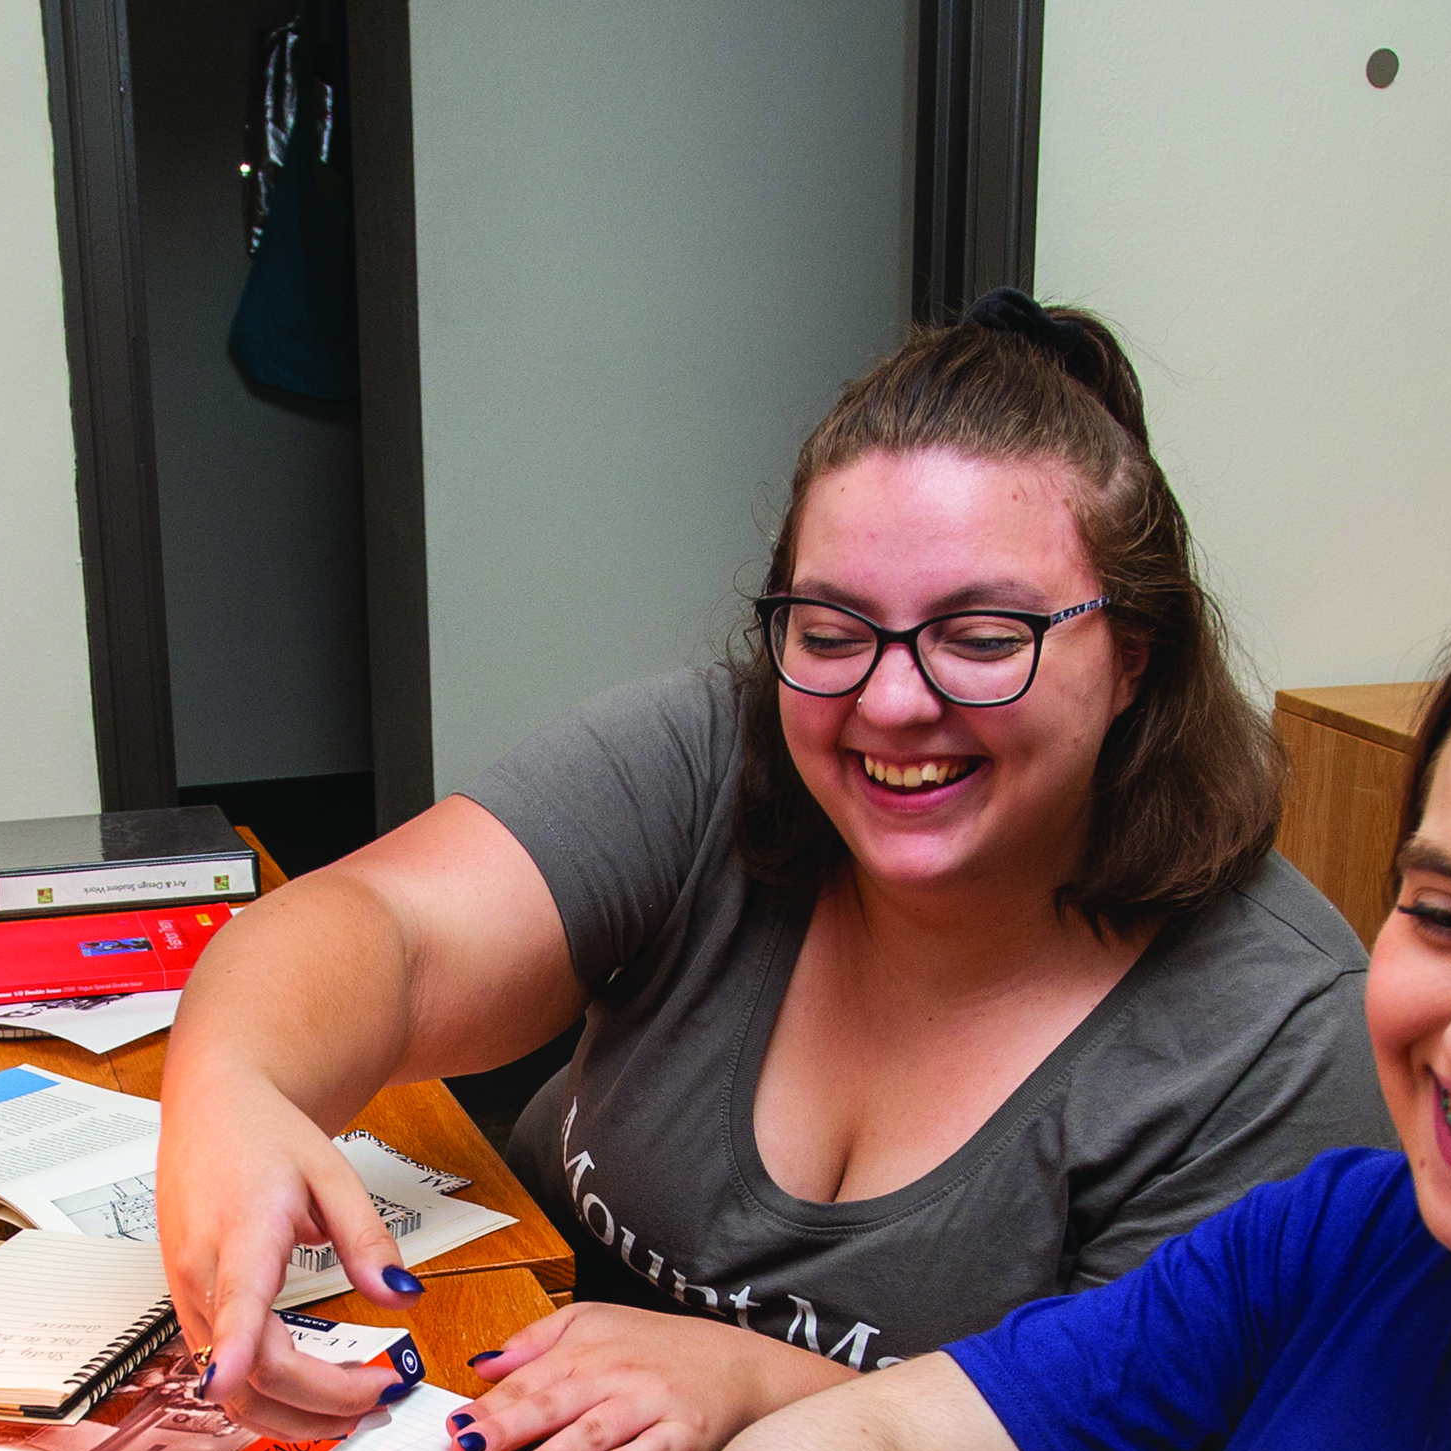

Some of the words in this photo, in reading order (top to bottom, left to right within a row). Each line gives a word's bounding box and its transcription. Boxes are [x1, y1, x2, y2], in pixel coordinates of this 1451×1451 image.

[106, 882, 136, 892] Student
[137, 881, 163, 890] Design
[175, 879, 187, 889] Art
[83, 885, 107, 894] Work
[296, 1317, 328, 1328] MARK
